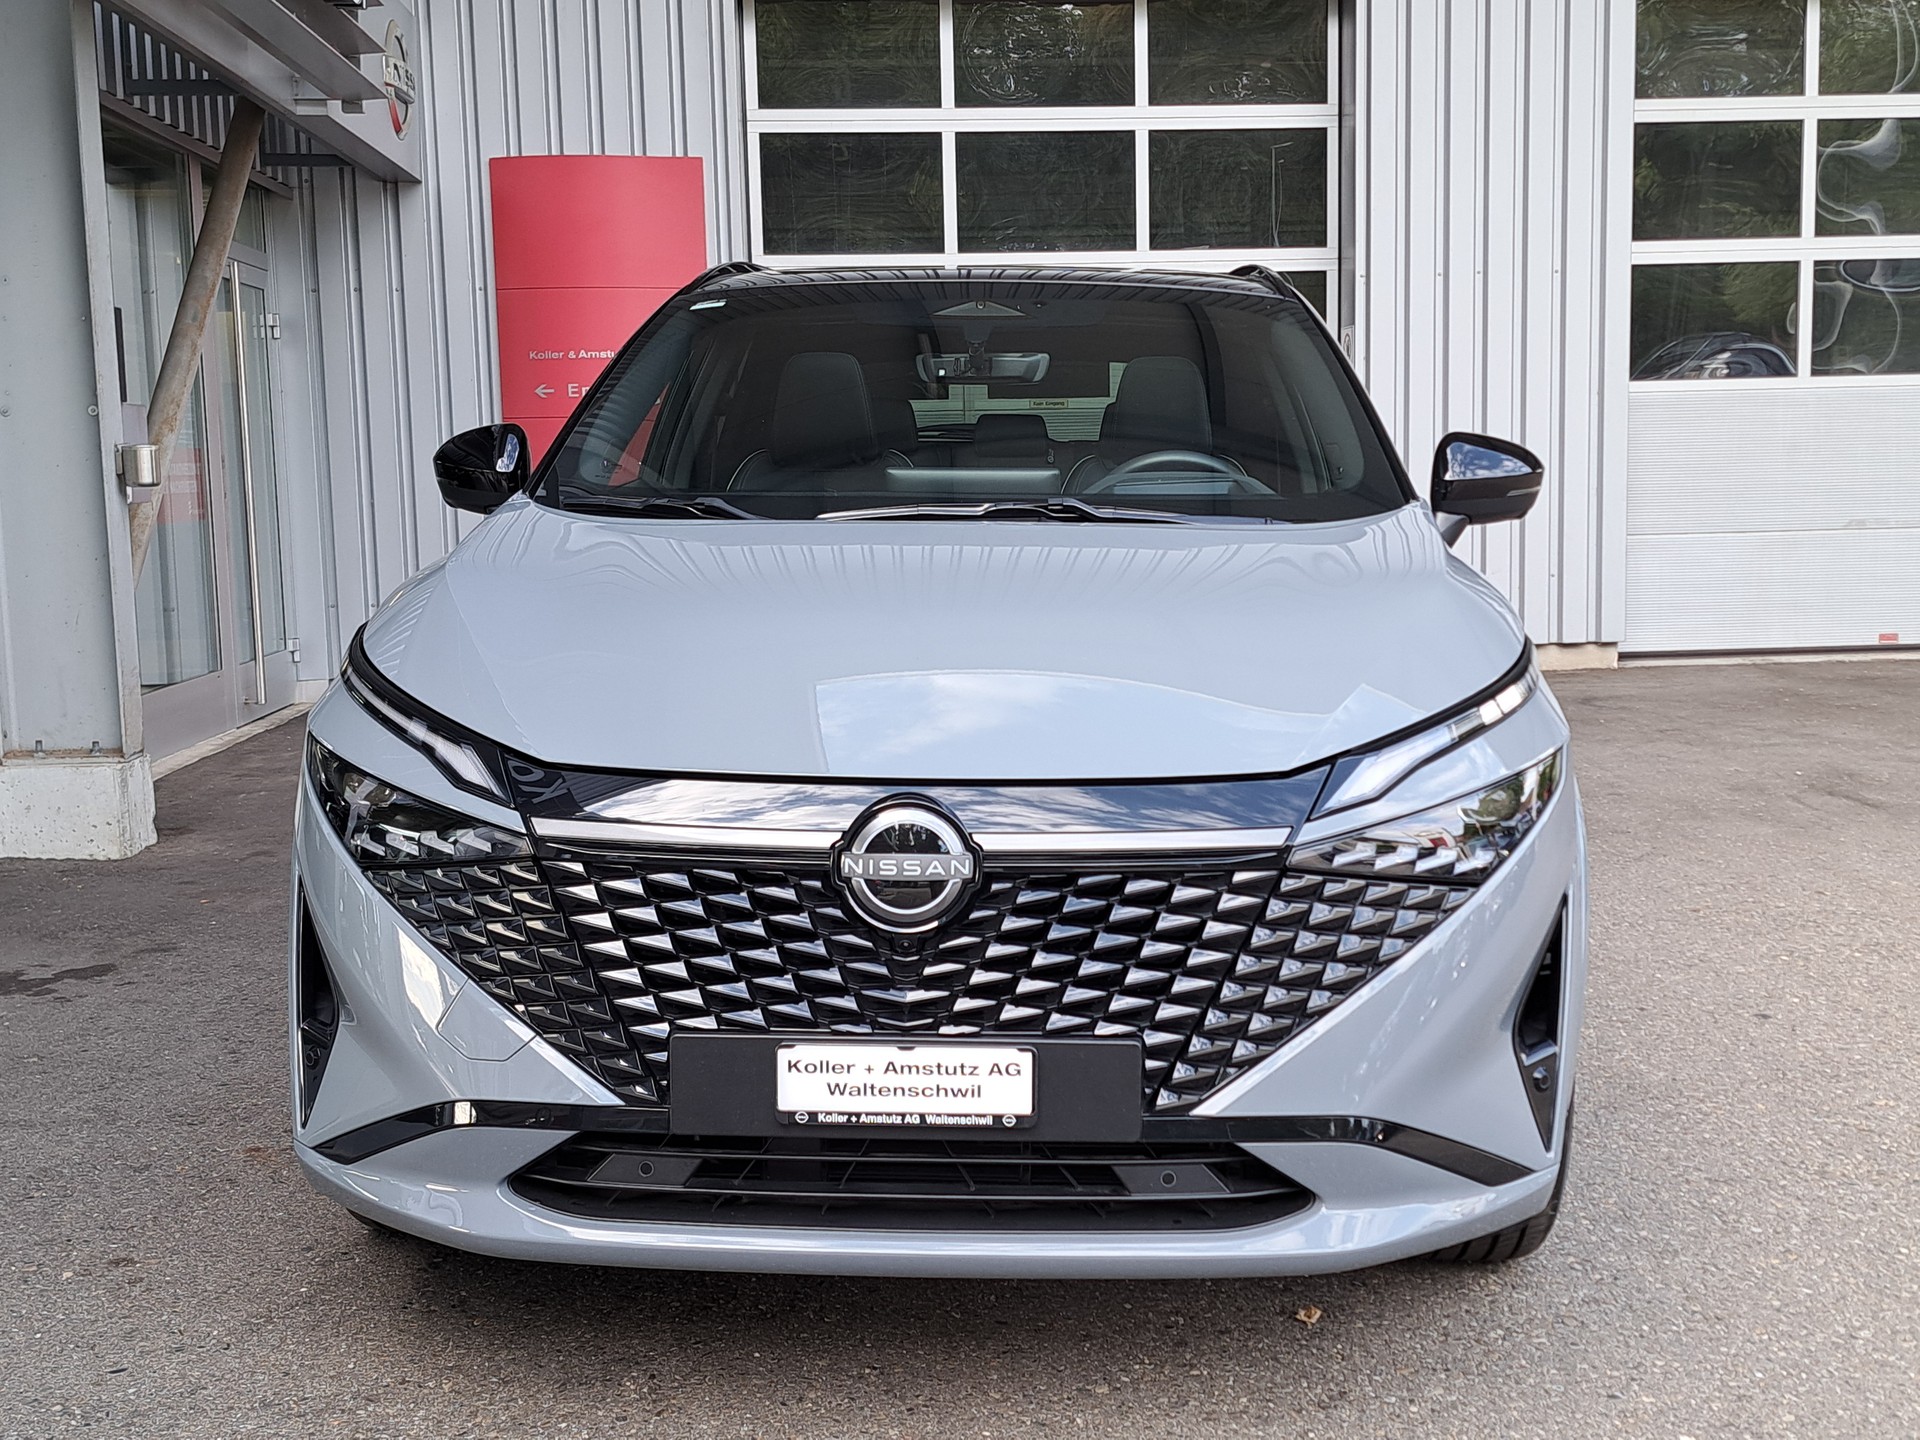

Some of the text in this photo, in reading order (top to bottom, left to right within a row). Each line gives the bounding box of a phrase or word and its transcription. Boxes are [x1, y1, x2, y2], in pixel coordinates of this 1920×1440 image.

[529, 350, 564, 360] Koller
[567, 350, 577, 359] &
[844, 858, 970, 876] NISSAN
[787, 1059, 1022, 1077] Koller + Amstutz AG
[826, 1082, 982, 1099] Waltenschwil
[817, 1112, 849, 1123] Koller
[850, 1114, 858, 1123] +
[859, 1113, 902, 1124] Amstutz
[904, 1113, 921, 1125] AG
[925, 1114, 994, 1126] Waltenschwil
